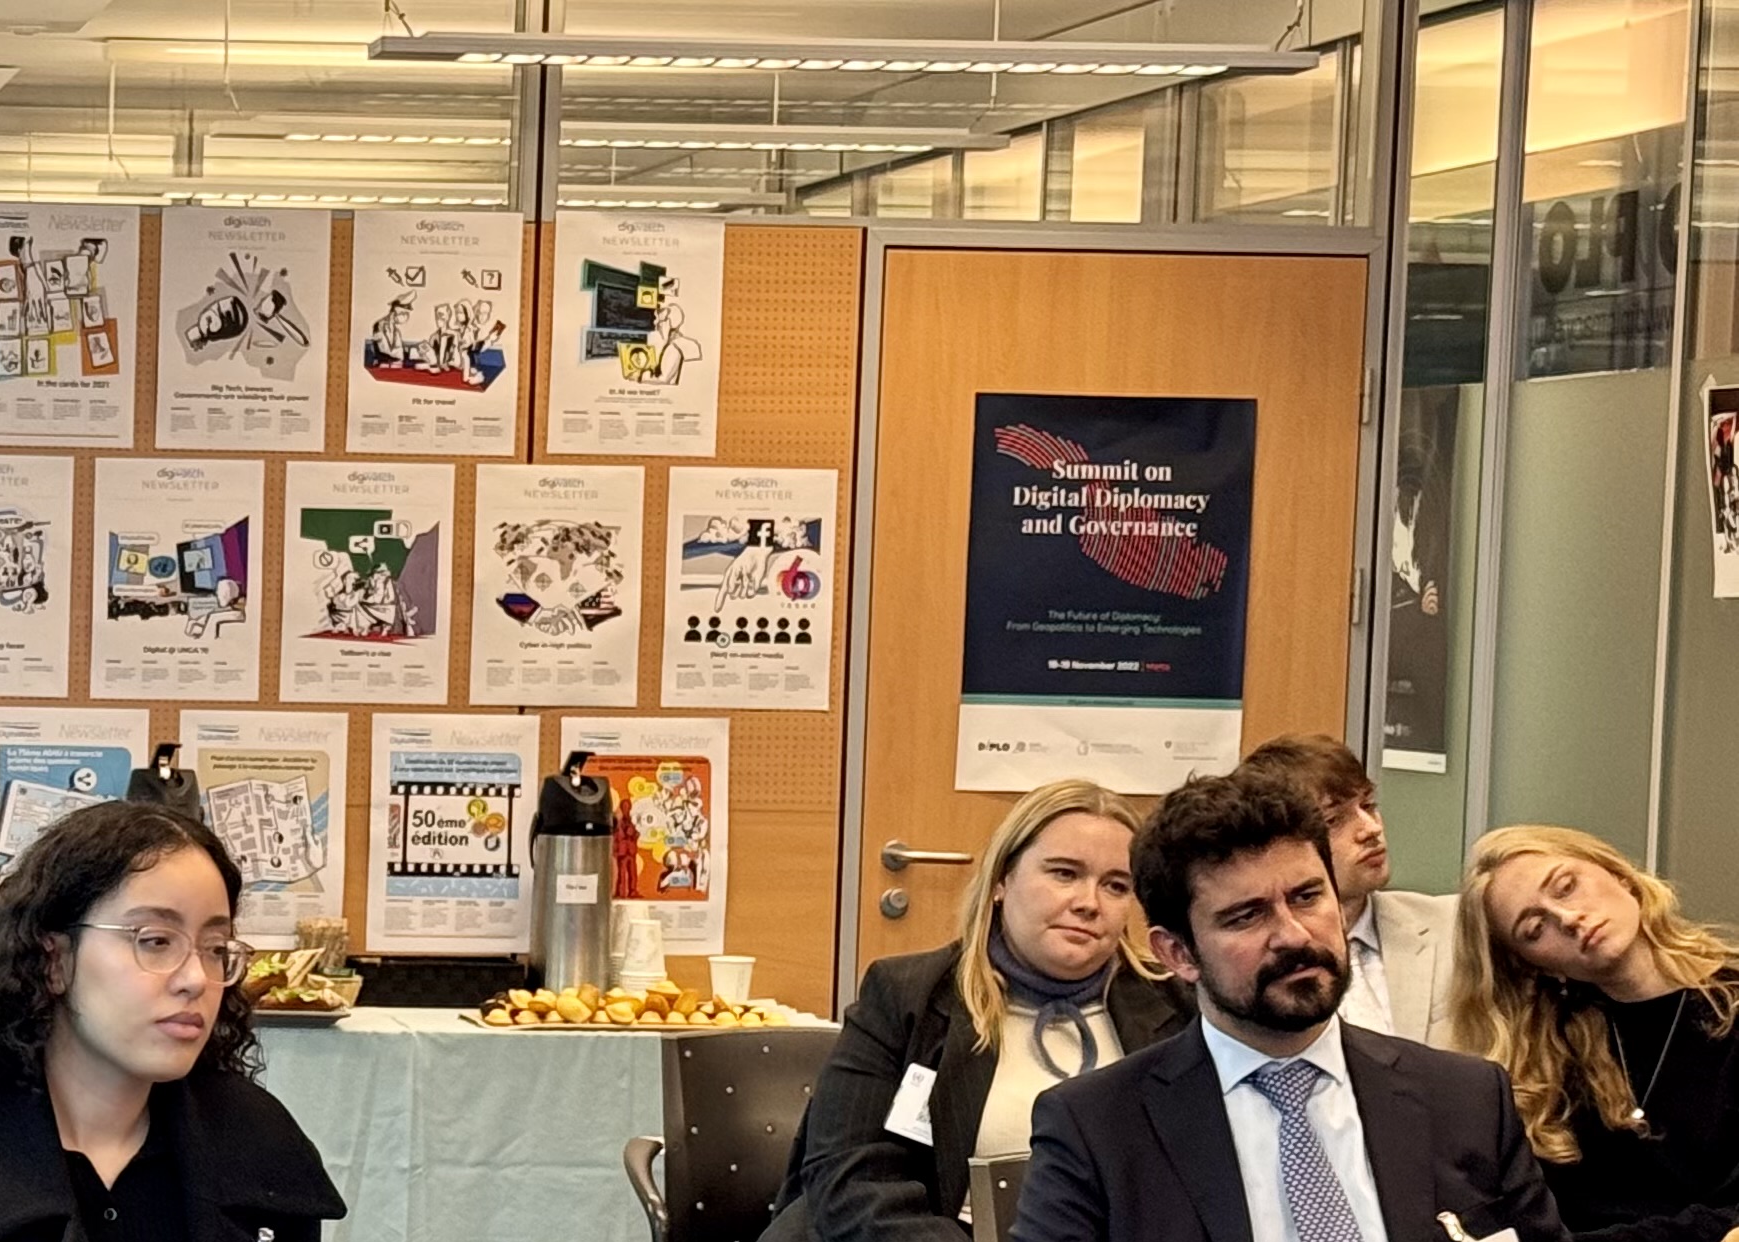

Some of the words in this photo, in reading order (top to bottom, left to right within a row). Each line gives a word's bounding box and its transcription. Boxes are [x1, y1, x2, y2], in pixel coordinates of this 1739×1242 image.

[48, 213, 127, 232] Newsletter
[208, 231, 286, 242] NEWSLETTER
[400, 235, 480, 246] NEWSLETTER
[602, 236, 680, 247] NEWSLETTER
[1052, 458, 1138, 482] Summit
[1144, 465, 1172, 482] on
[142, 481, 220, 490] NEWSLETTER
[332, 484, 410, 494] NEWSLETTER
[524, 489, 599, 500] NEWSLETTER
[715, 490, 793, 500] NEWSLETTER
[1013, 484, 1088, 511] Digital
[1096, 487, 1211, 514] Diplomacy
[1021, 514, 1063, 535] and
[1069, 514, 1199, 538] Governance
[1048, 610, 1066, 620] The
[1068, 610, 1098, 620] Future
[1100, 610, 1110, 620] of
[1006, 620, 1032, 631] From
[1032, 622, 1084, 634] Geopolitics
[1086, 623, 1096, 632] to
[1098, 623, 1141, 635] Emerging
[1143, 624, 1202, 636] Technologies
[59, 724, 134, 740] Newsletter
[258, 726, 332, 742] Newsletter
[450, 730, 524, 746] Newsletter
[640, 734, 712, 750] Newsletter
[411, 830, 470, 846] édition
